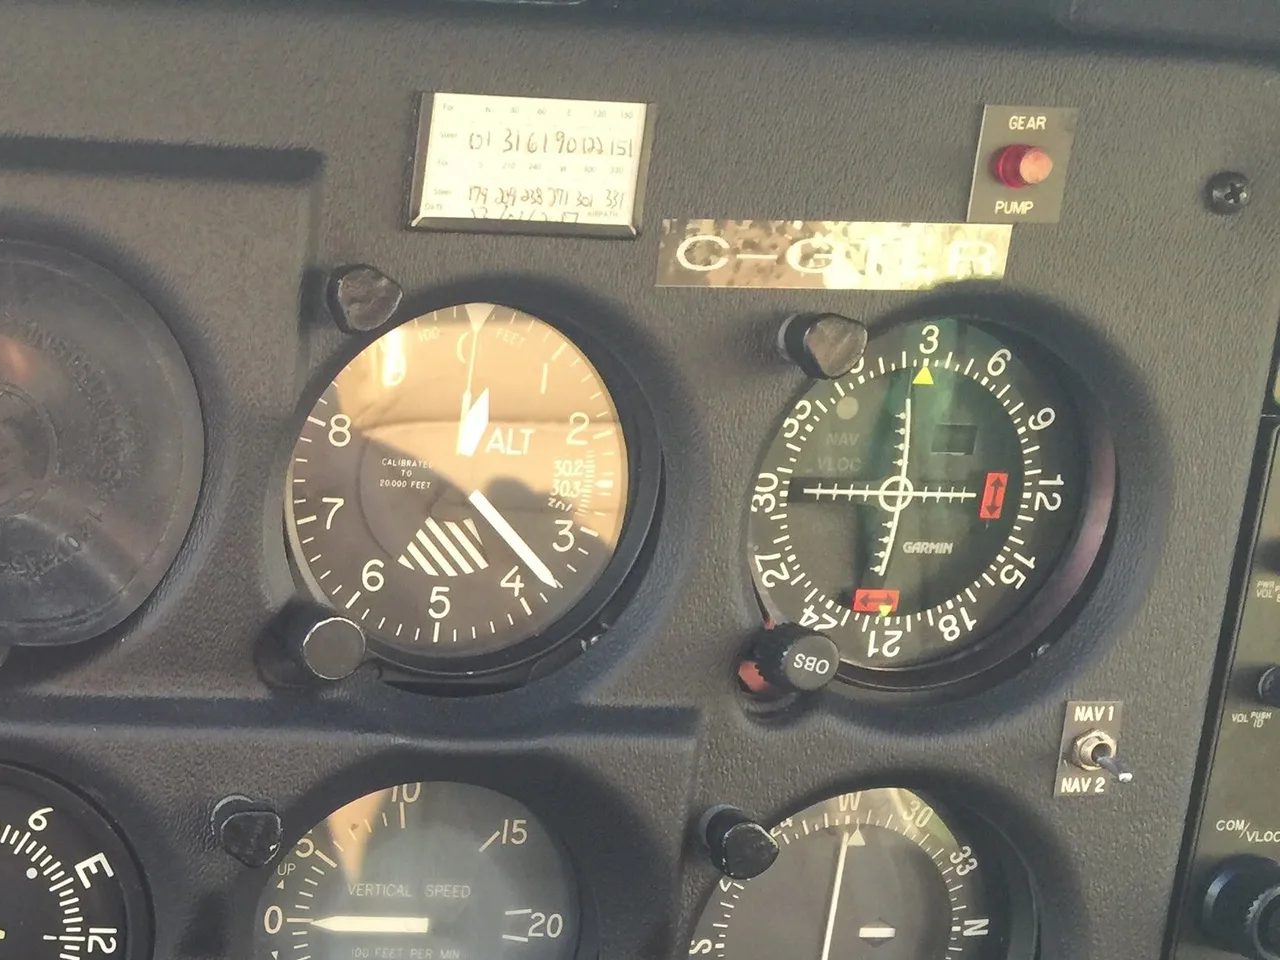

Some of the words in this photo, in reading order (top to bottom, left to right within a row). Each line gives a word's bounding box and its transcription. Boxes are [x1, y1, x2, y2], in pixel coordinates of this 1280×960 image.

[1009, 115, 1047, 131] GEAR
[994, 200, 1035, 216] PUMP
[328, 414, 352, 447] 8
[484, 428, 536, 455] ALT
[566, 412, 589, 445] 2
[1034, 474, 1065, 512] 12
[903, 541, 953, 554] GARMIN
[428, 587, 451, 619] 5
[937, 607, 978, 642] 18
[793, 653, 830, 675] OBS
[1075, 705, 1102, 722] NAV
[1107, 705, 1116, 722] 1
[501, 819, 527, 845] 15
[74, 852, 115, 889] E
[277, 863, 296, 877] UP
[348, 883, 412, 898] VERTICAL
[425, 884, 470, 898] SPEED
[527, 913, 563, 939] 20
